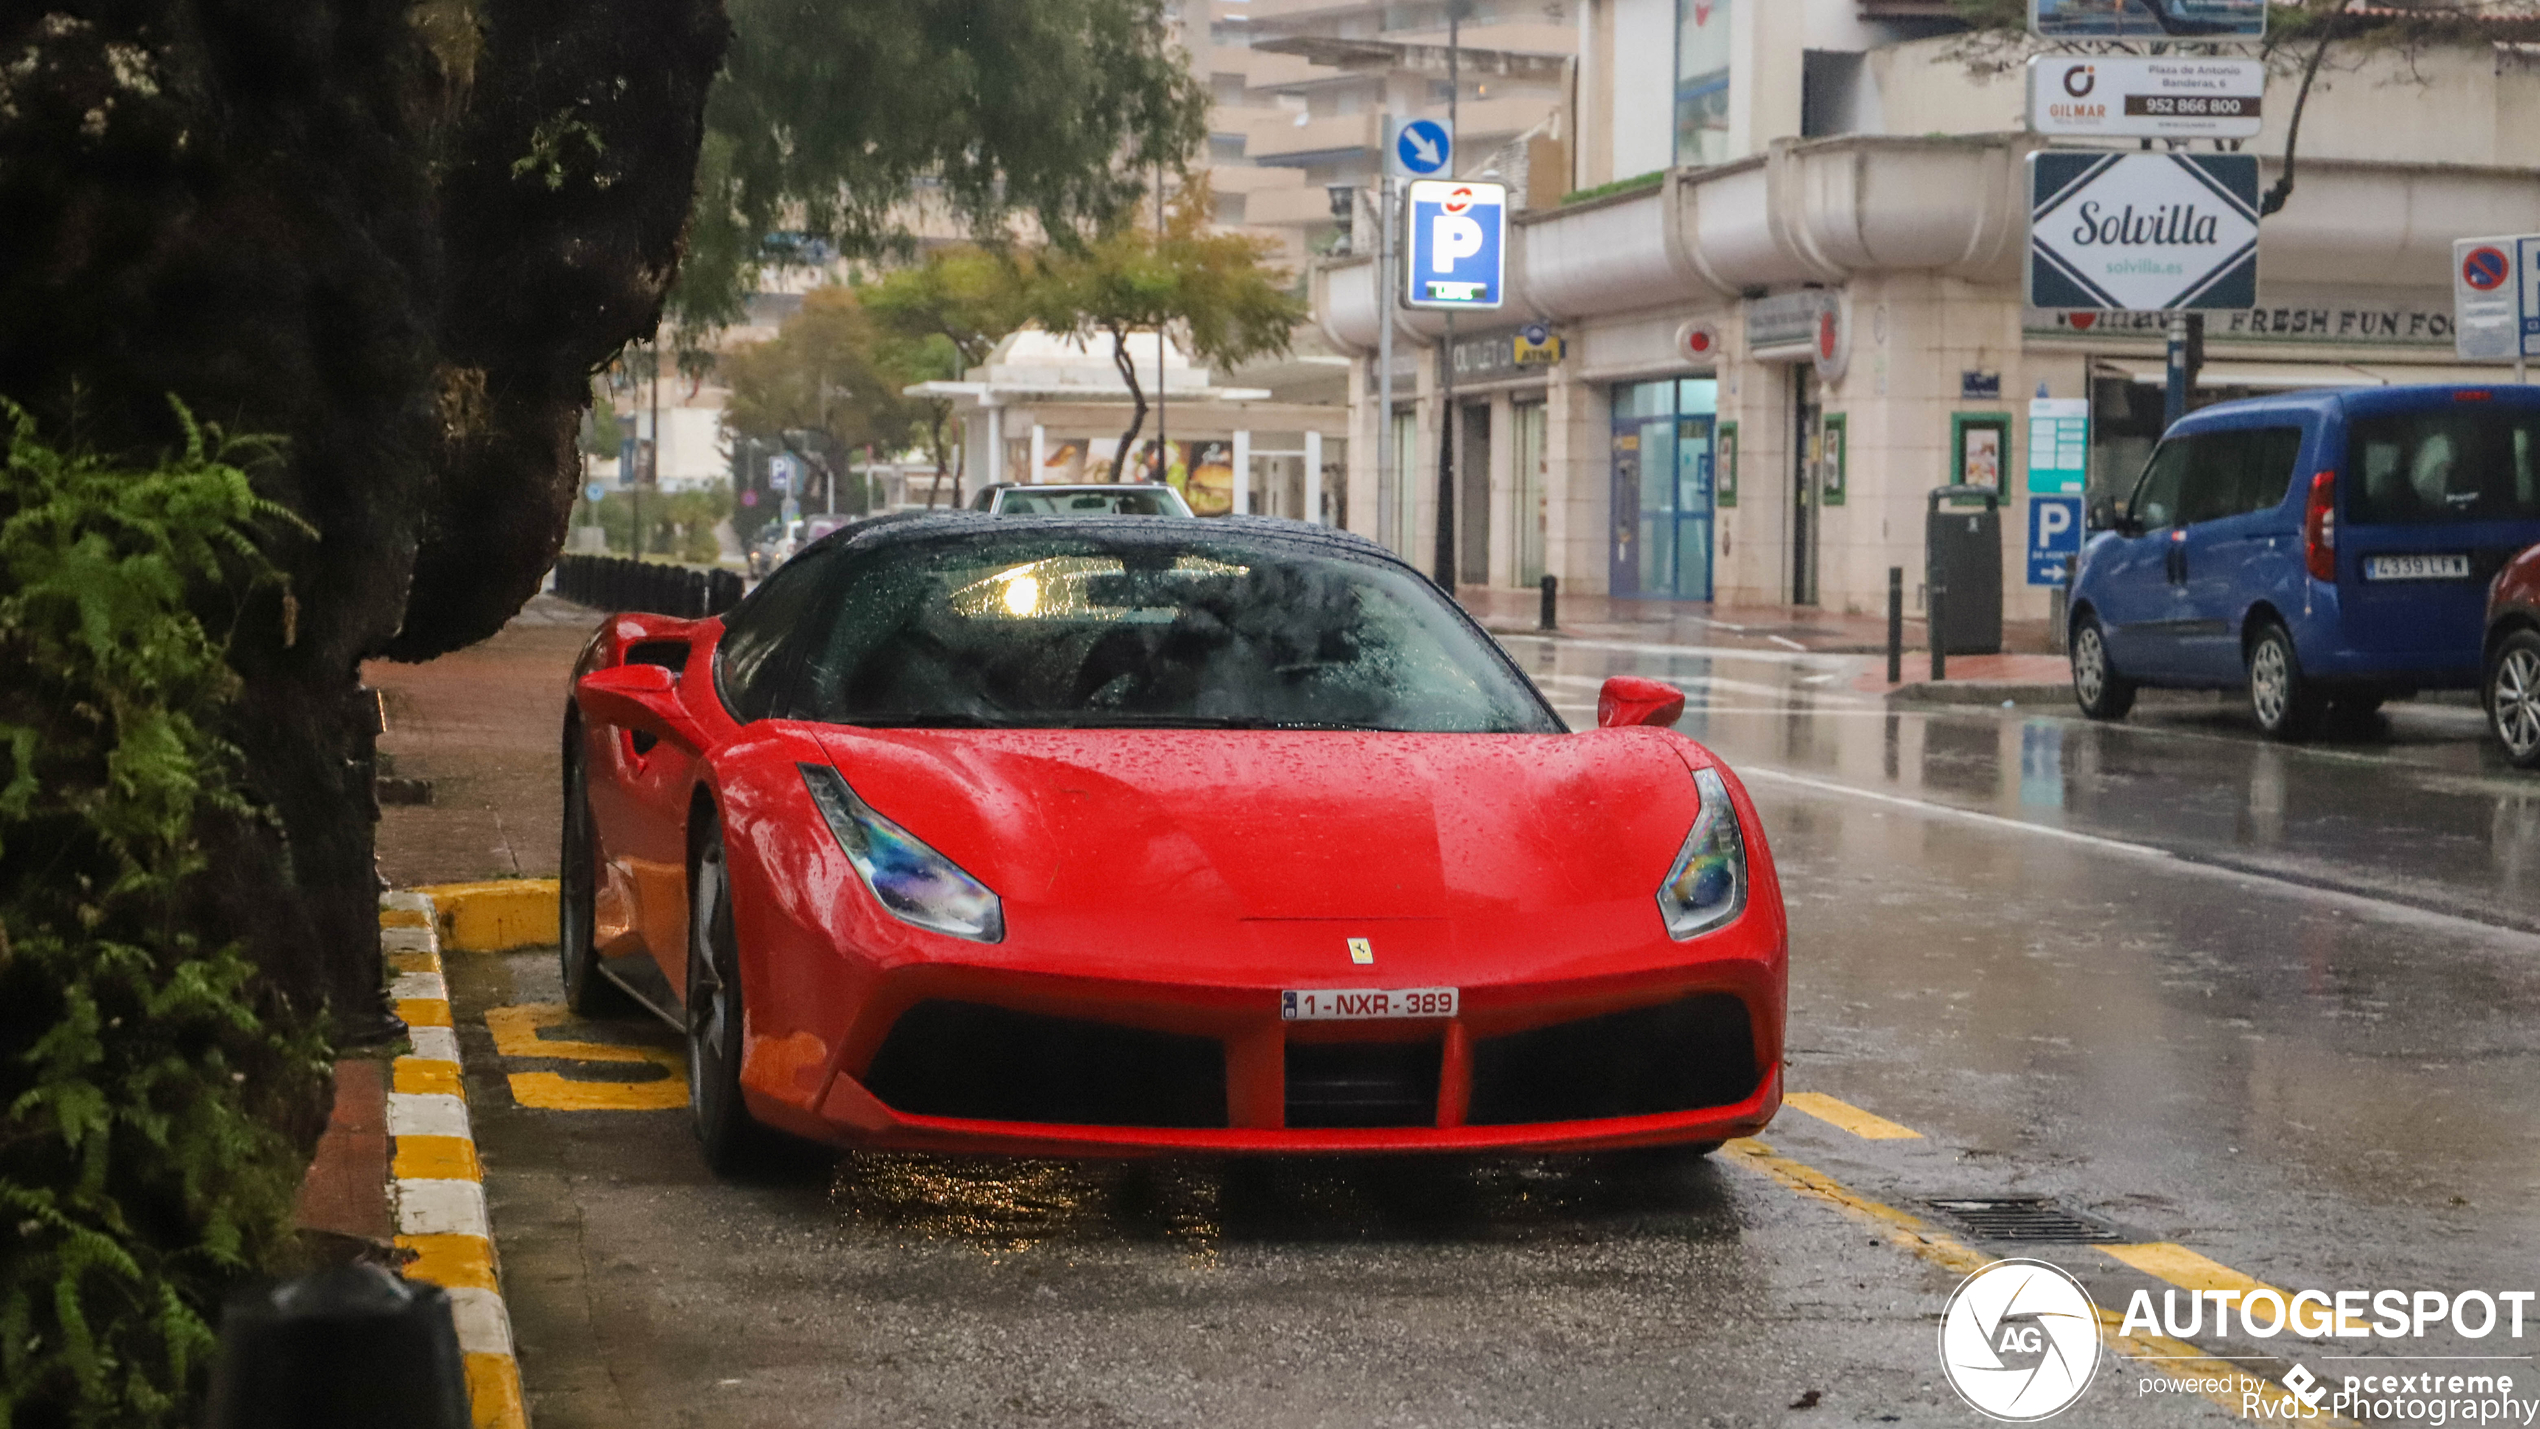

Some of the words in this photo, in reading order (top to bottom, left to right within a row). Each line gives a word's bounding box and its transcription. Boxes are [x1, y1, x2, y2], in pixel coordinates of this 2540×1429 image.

[2149, 65, 2178, 75] Plaza
[2181, 65, 2194, 75] de
[2197, 65, 2241, 75] Antonio
[2050, 104, 2106, 118] GILMAR
[2146, 98, 2175, 113] 952
[2177, 99, 2207, 114] 866
[2210, 99, 2241, 114] 800
[2073, 200, 2218, 246] Solvilla
[1432, 215, 1483, 274] P
[2105, 258, 2184, 275] solvilla.es
[2229, 308, 2329, 334] FRESH
[2338, 311, 2401, 336] FUN
[2408, 312, 2456, 337] FO
[1521, 350, 1553, 362] ATM
[2039, 502, 2072, 549] P
[1304, 993, 1453, 1016] 1-NXR-389
